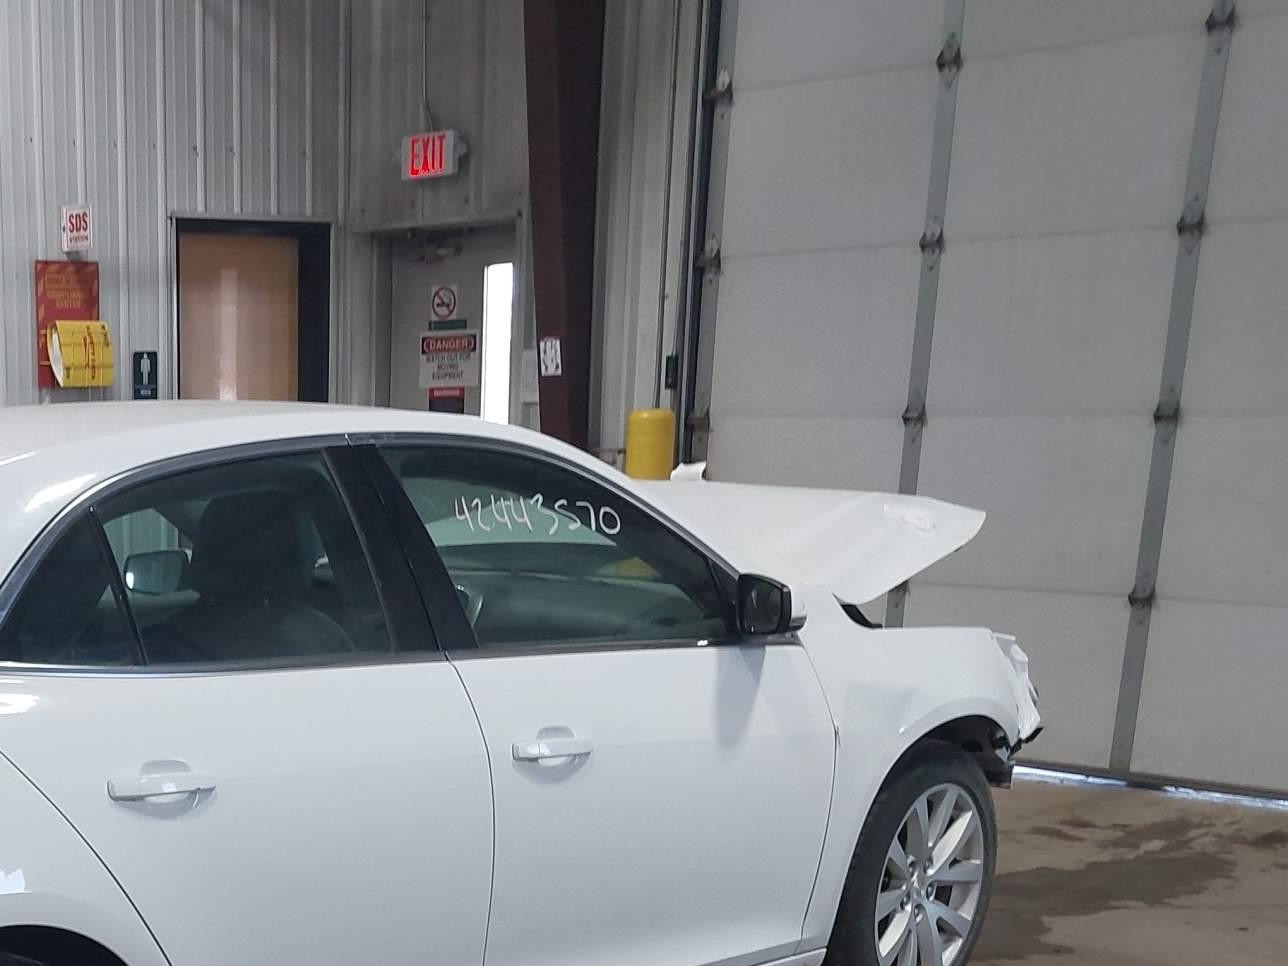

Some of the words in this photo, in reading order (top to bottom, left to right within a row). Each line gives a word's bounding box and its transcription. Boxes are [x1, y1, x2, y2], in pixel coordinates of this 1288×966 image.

[410, 134, 446, 176] EXIT
[68, 212, 88, 233] SDS
[429, 338, 469, 351] DANGER
